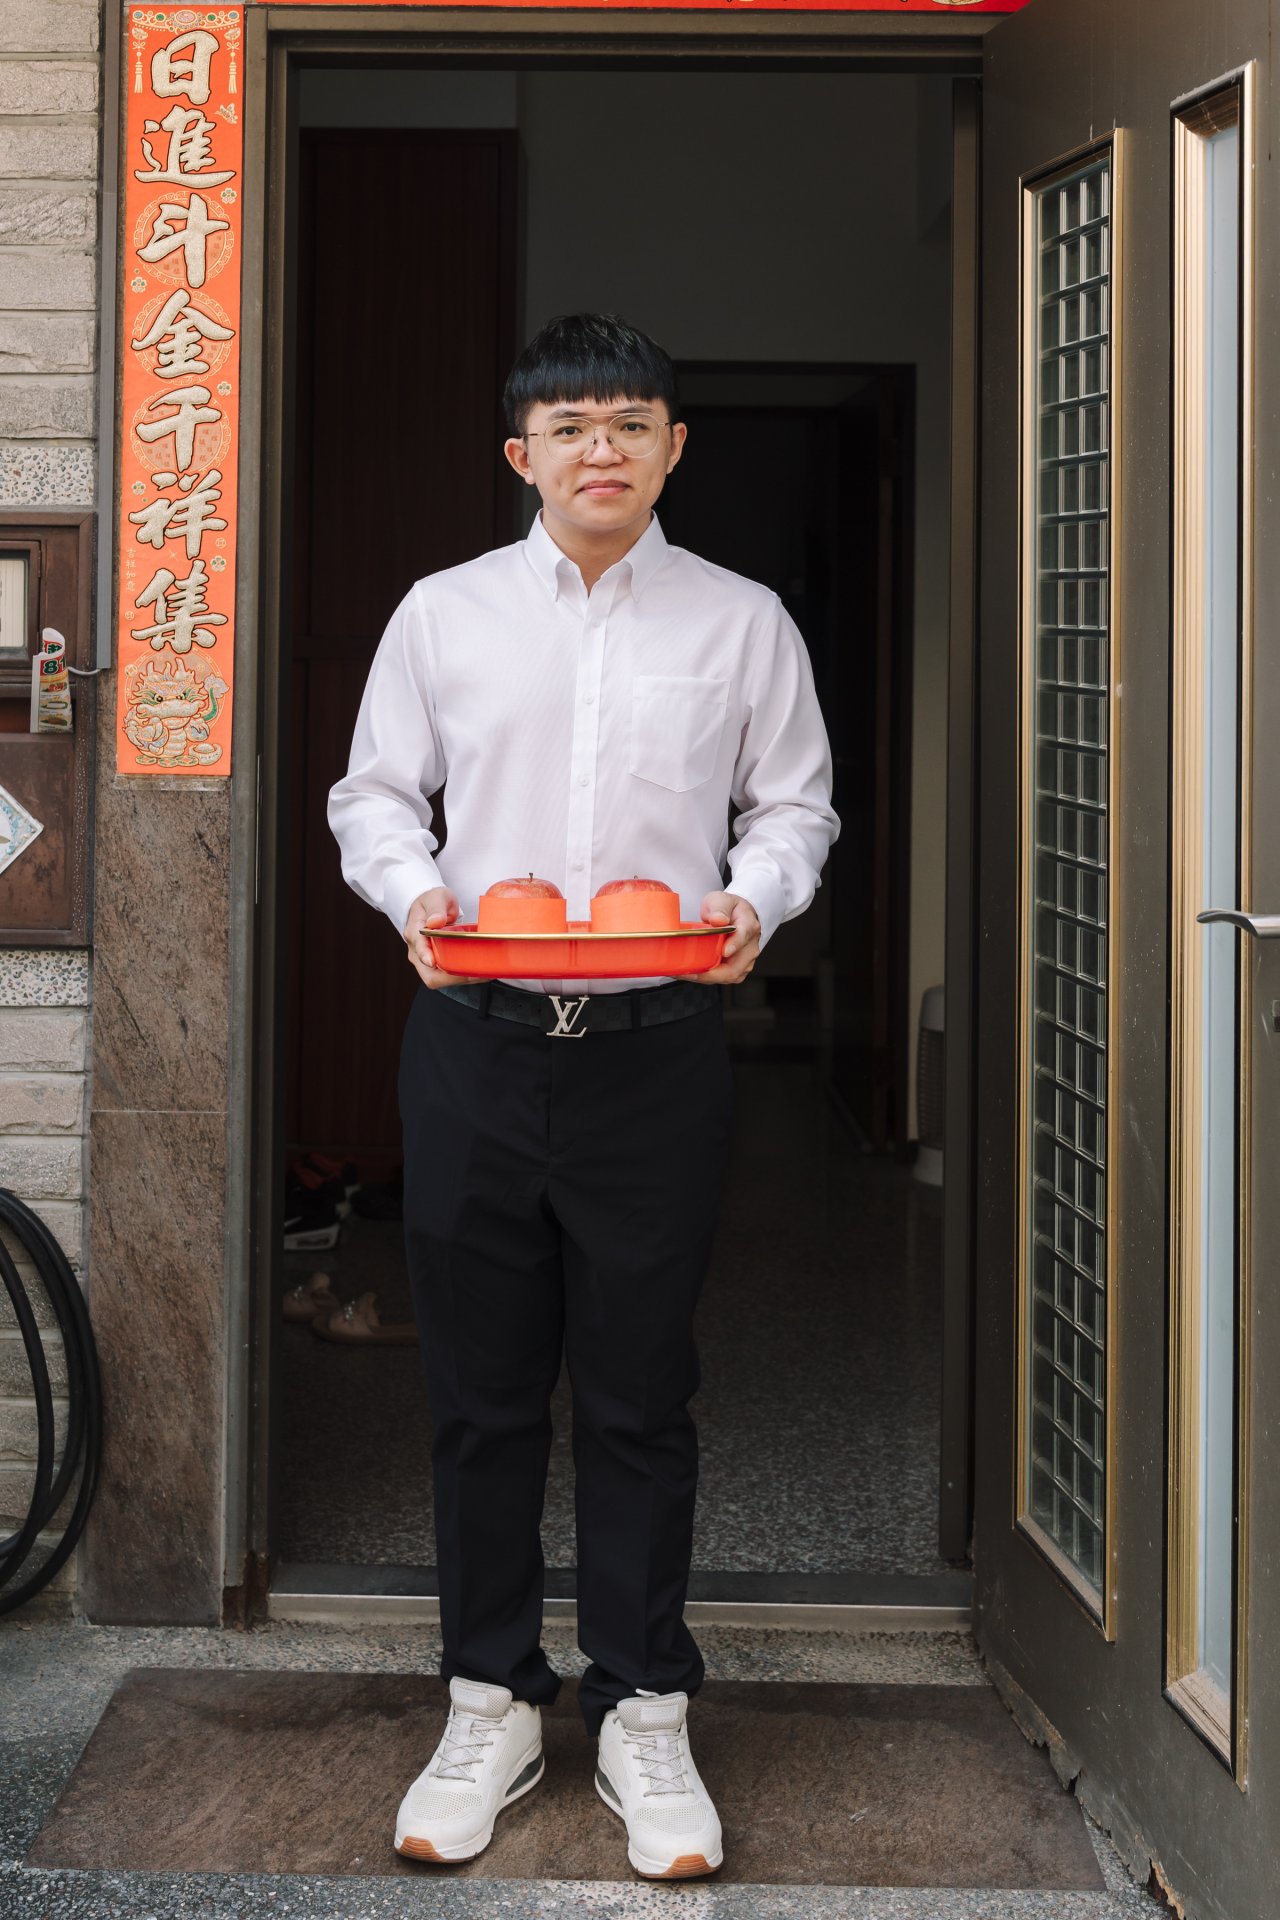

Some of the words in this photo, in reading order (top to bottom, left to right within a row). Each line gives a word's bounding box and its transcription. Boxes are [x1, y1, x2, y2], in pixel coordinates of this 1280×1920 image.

[128, 30, 237, 654] 日進斗金千祥集
[125, 548, 136, 592] 吉祥如意
[546, 995, 590, 1038] LV
